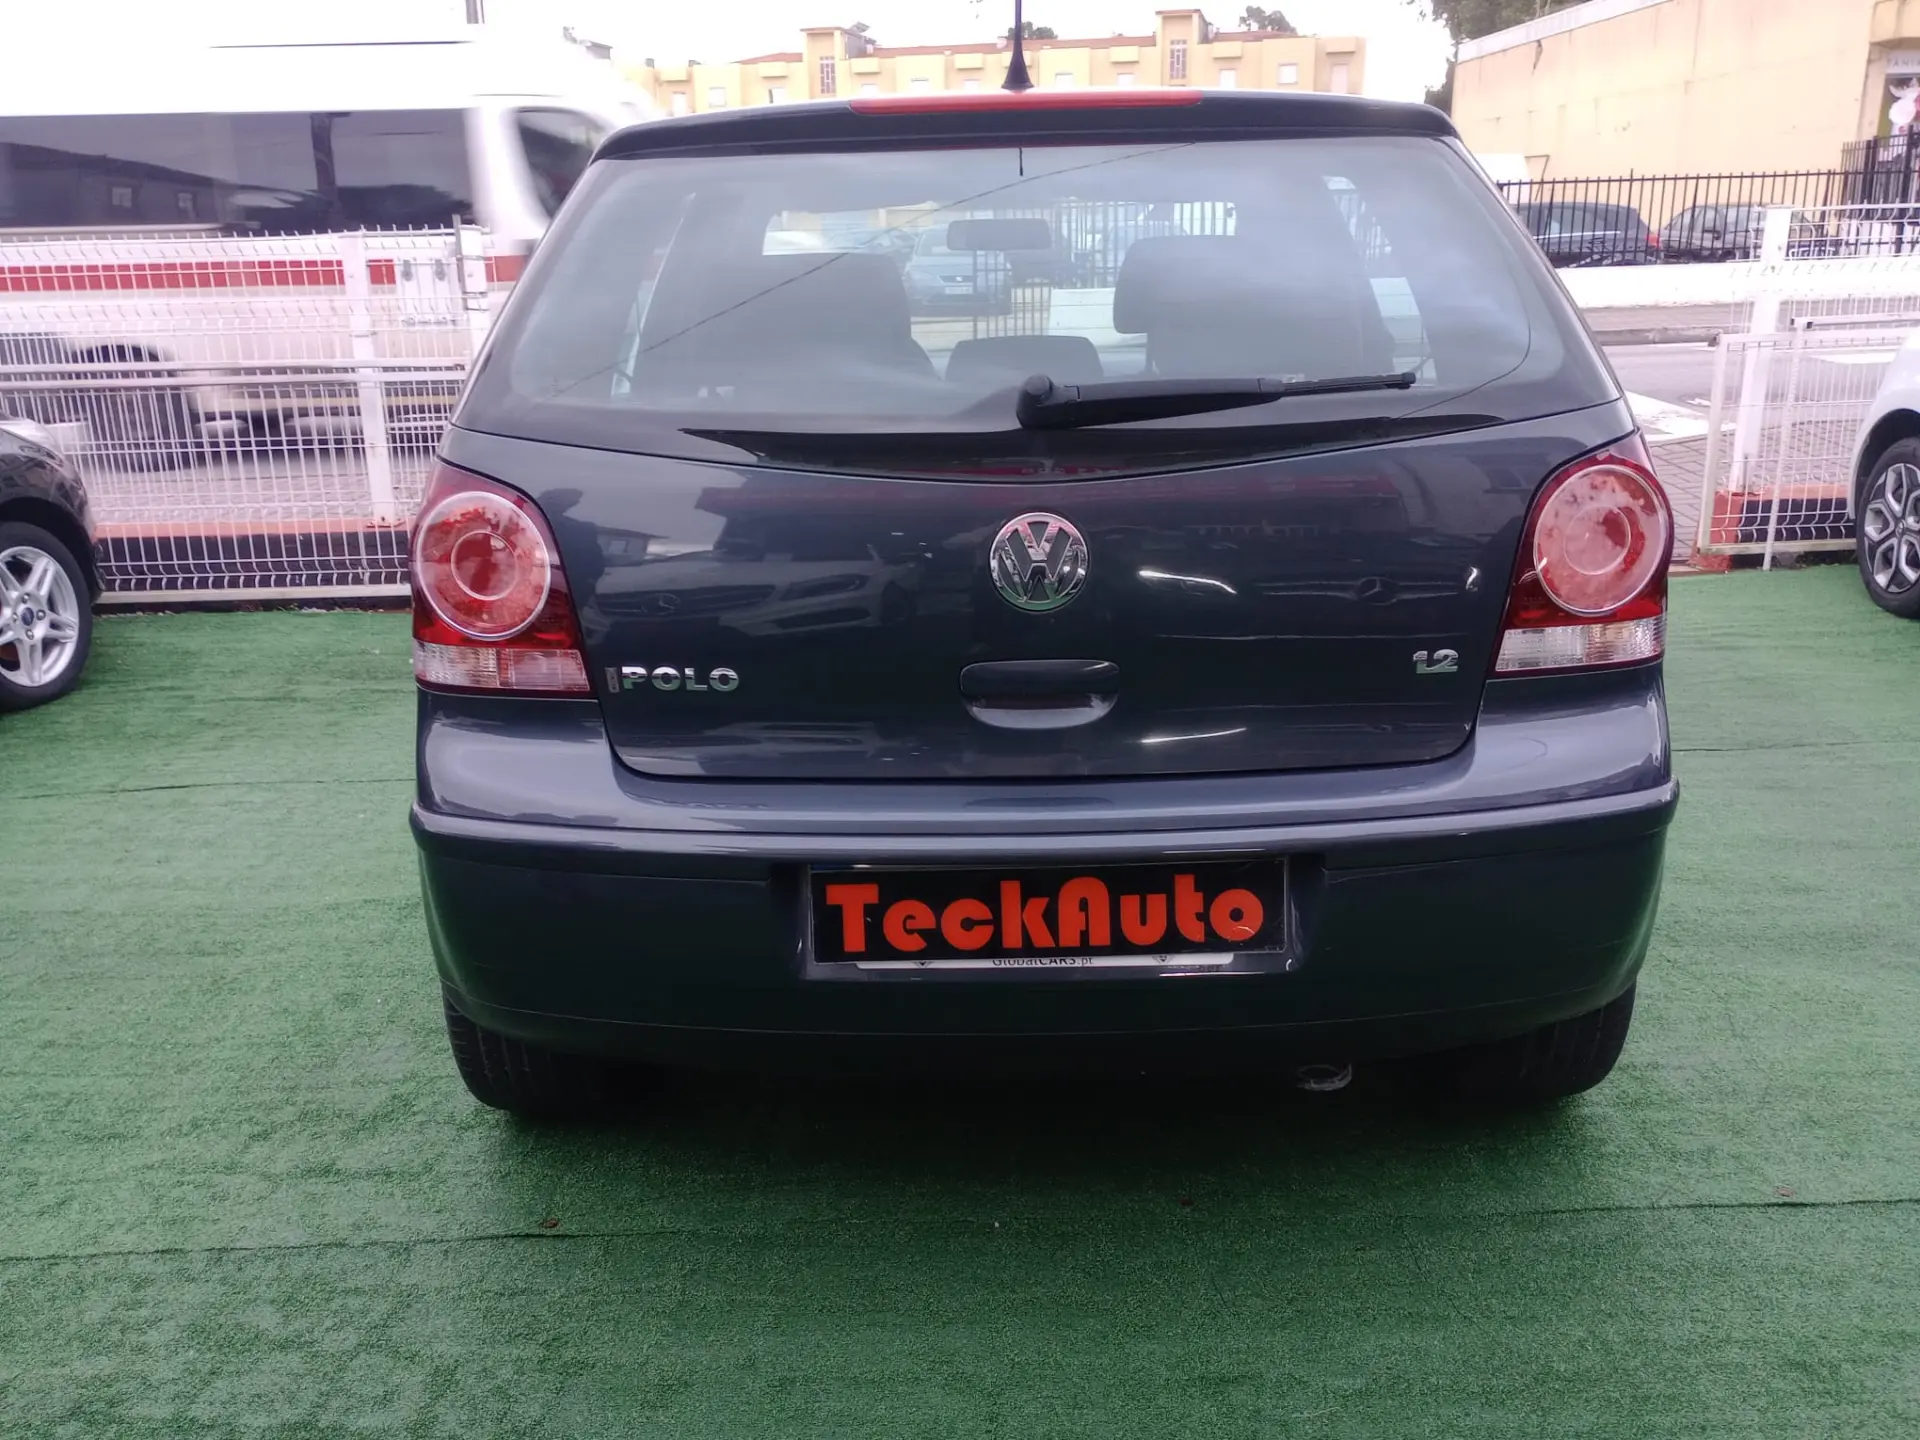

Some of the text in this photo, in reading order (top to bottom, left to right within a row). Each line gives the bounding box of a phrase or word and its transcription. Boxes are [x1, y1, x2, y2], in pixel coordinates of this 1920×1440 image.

[990, 512, 1087, 611] VW
[621, 666, 740, 692] POLO
[825, 873, 1264, 952] TeckAuto
